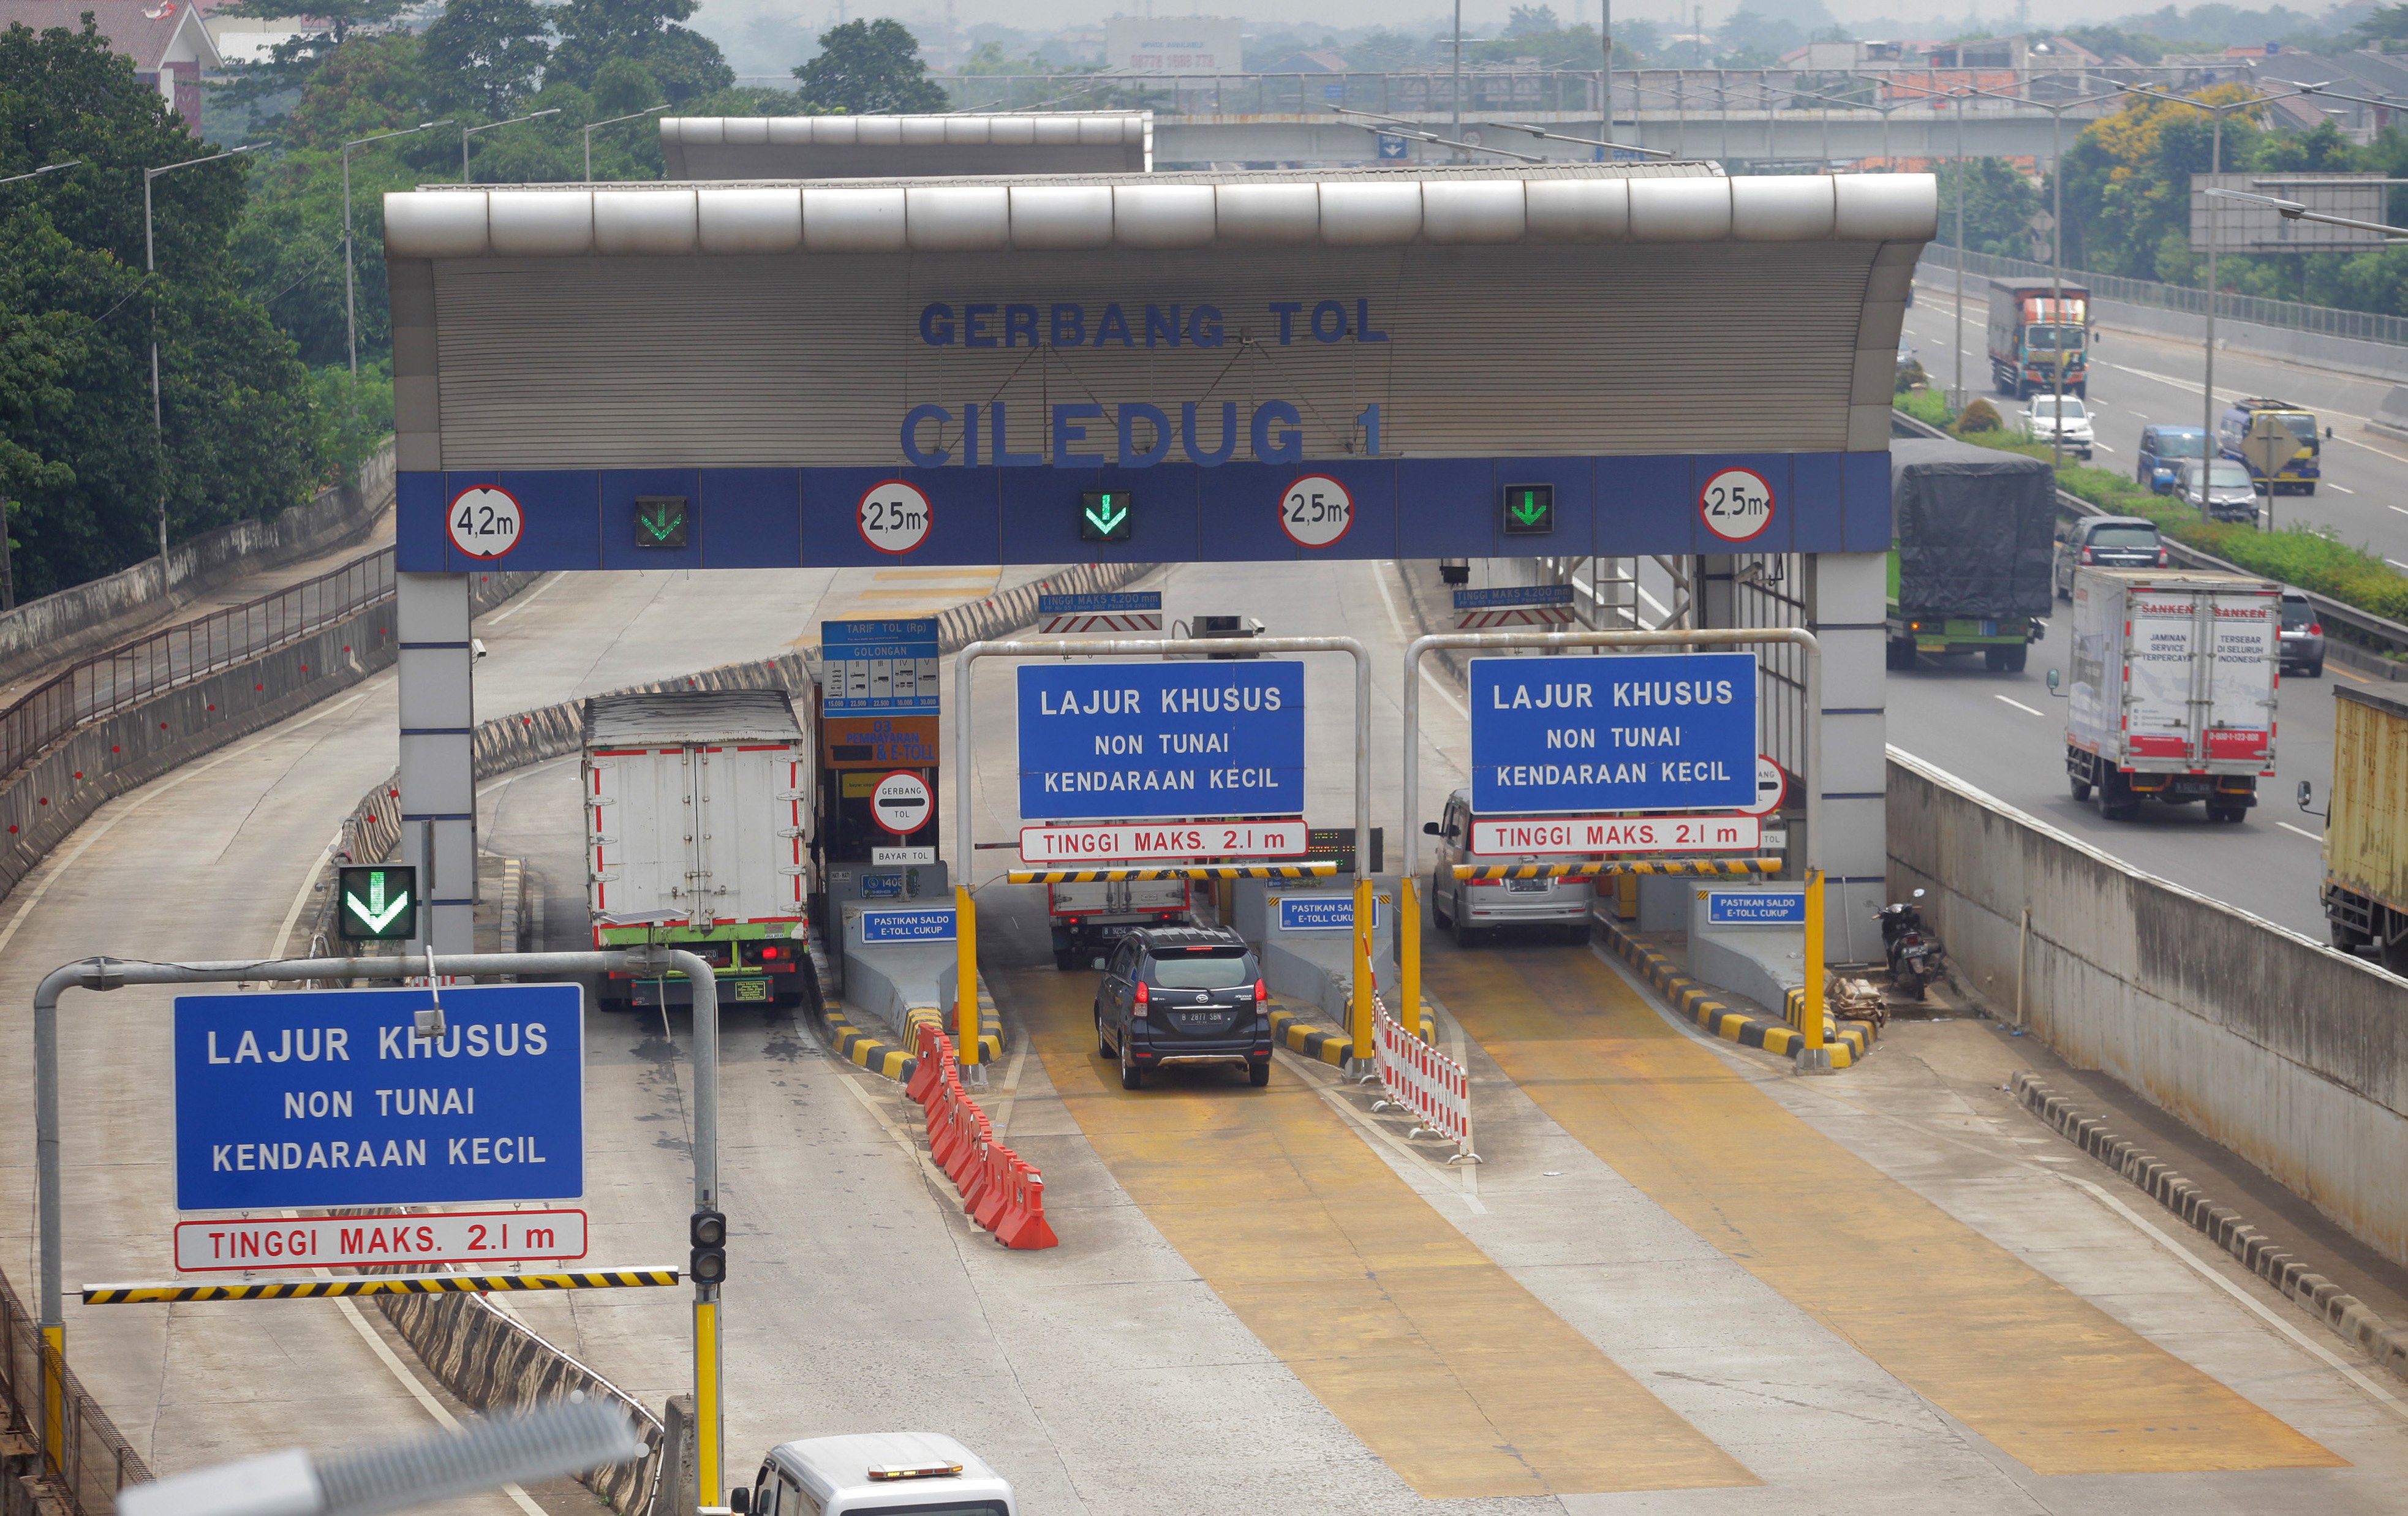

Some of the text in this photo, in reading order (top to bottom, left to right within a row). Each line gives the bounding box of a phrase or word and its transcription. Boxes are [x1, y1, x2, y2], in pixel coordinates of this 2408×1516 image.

[920, 299, 1389, 348] GERBANG TOL
[900, 400, 1380, 469] CILEDUG 1
[1291, 494, 1342, 526] 2,5m
[1712, 488, 1762, 518] 2,5m
[457, 505, 514, 538] 4,2m
[869, 502, 920, 533] 2,5m
[1043, 596, 1073, 606] TINGGI
[1078, 595, 1107, 605] MAKS
[1111, 594, 1139, 603] 4.200
[1457, 590, 1488, 600] TINGGI
[1492, 589, 1520, 599] MAKS
[1525, 587, 1552, 597] 4.200
[2142, 604, 2195, 614] SANKEN
[2214, 608, 2266, 618] SANKEN
[847, 623, 926, 634] TARIF TOL (Rp)
[855, 647, 906, 656] GOLONGAN
[1041, 687, 1281, 715] LAJUR KHUSUS
[1494, 681, 1732, 709] LAJUR KHUSUS
[847, 732, 920, 744] PEMBAYARAN
[874, 720, 892, 733] 03
[1548, 727, 1679, 749] NON TUNAI
[877, 744, 936, 761] & E-TOLL
[1096, 733, 1228, 755] NON TUNAI
[1045, 767, 1278, 793] KENDARAAN KECIL
[1498, 761, 1730, 786] KENDARAAN KECIL
[1044, 834, 1118, 853] TINGGI
[1135, 832, 1205, 851] MAKS.
[1265, 834, 1284, 848] m
[1496, 827, 1570, 847] TINGGI
[1588, 826, 1658, 845] MAKS.
[1718, 829, 1737, 842] m
[1191, 1013, 1206, 1021] 2877
[208, 1022, 548, 1063] LAJUR KHUSUS
[285, 1088, 473, 1118] NON TUNAI
[214, 1137, 545, 1171] KENDARAAN KECIL
[209, 1230, 315, 1258] TINGGI
[341, 1226, 441, 1254] MAKS.
[527, 1229, 553, 1248] m
